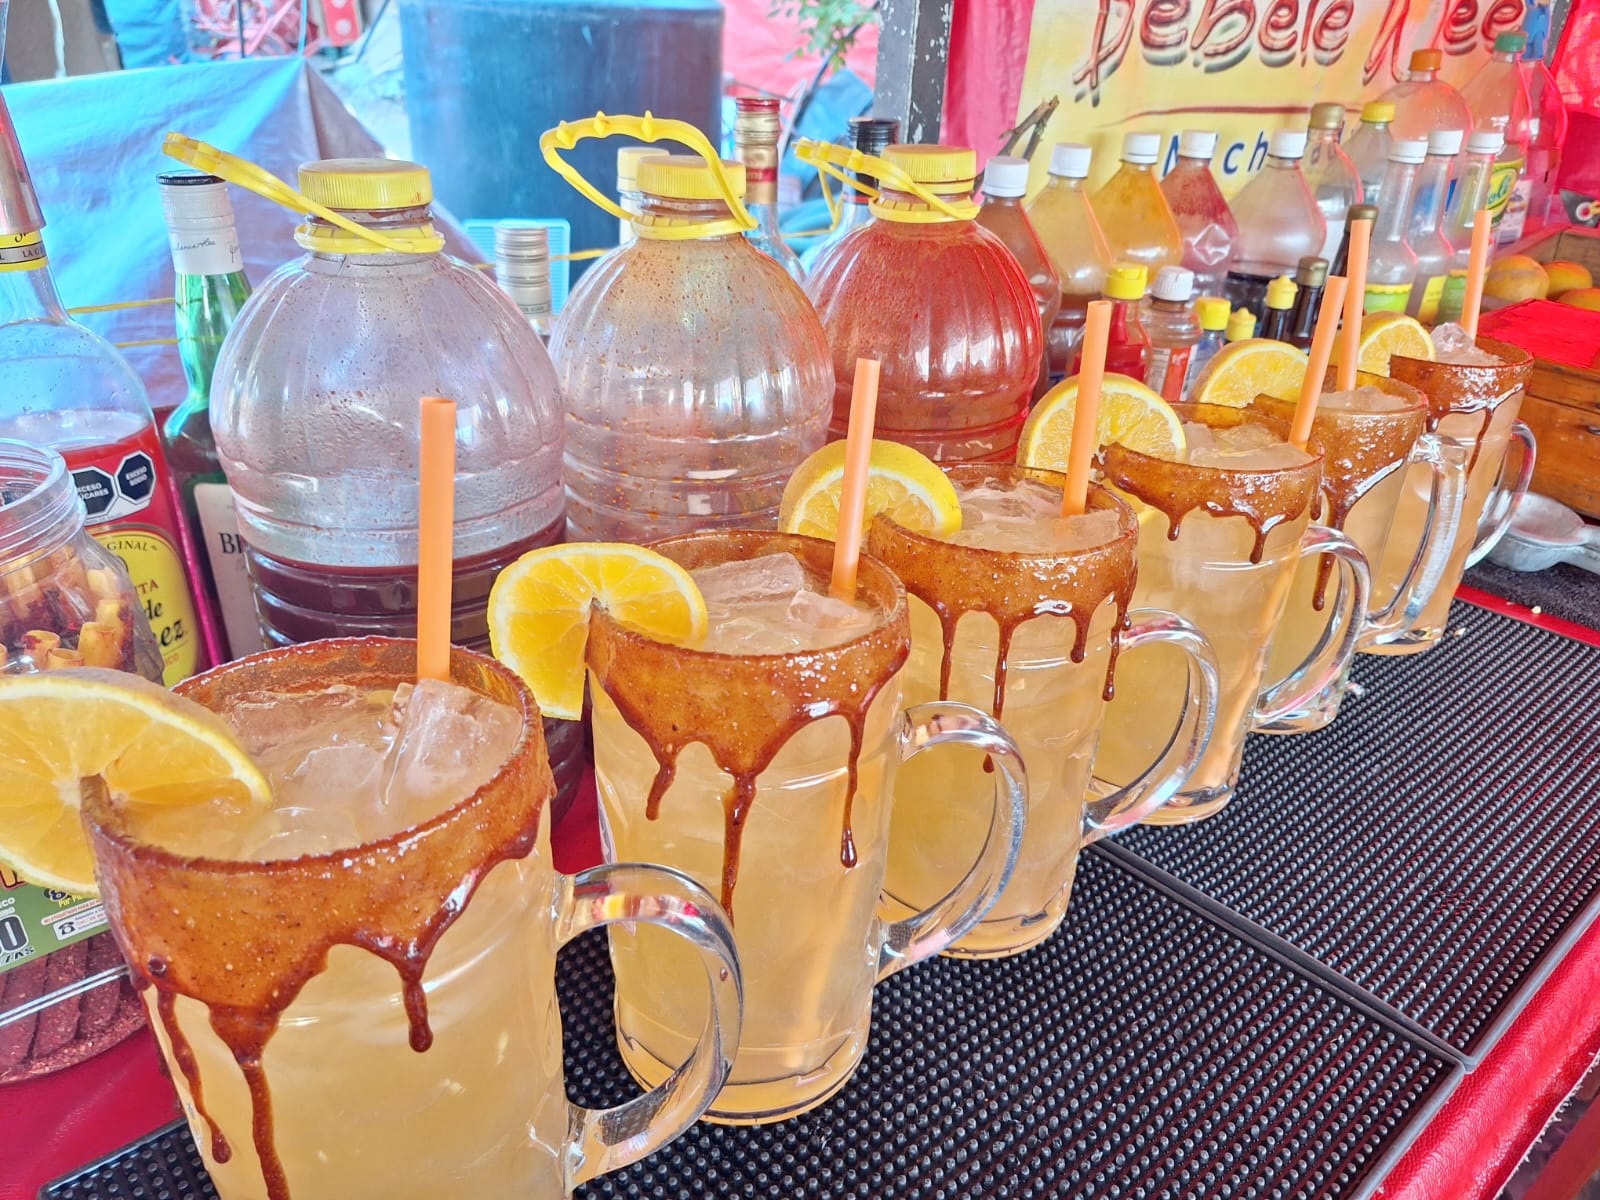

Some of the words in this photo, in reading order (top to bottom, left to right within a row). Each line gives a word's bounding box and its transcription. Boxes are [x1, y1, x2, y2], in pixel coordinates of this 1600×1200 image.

[78, 482, 103, 493] CESO
[79, 488, 110, 500] CARES
[106, 540, 148, 552] GINAL
